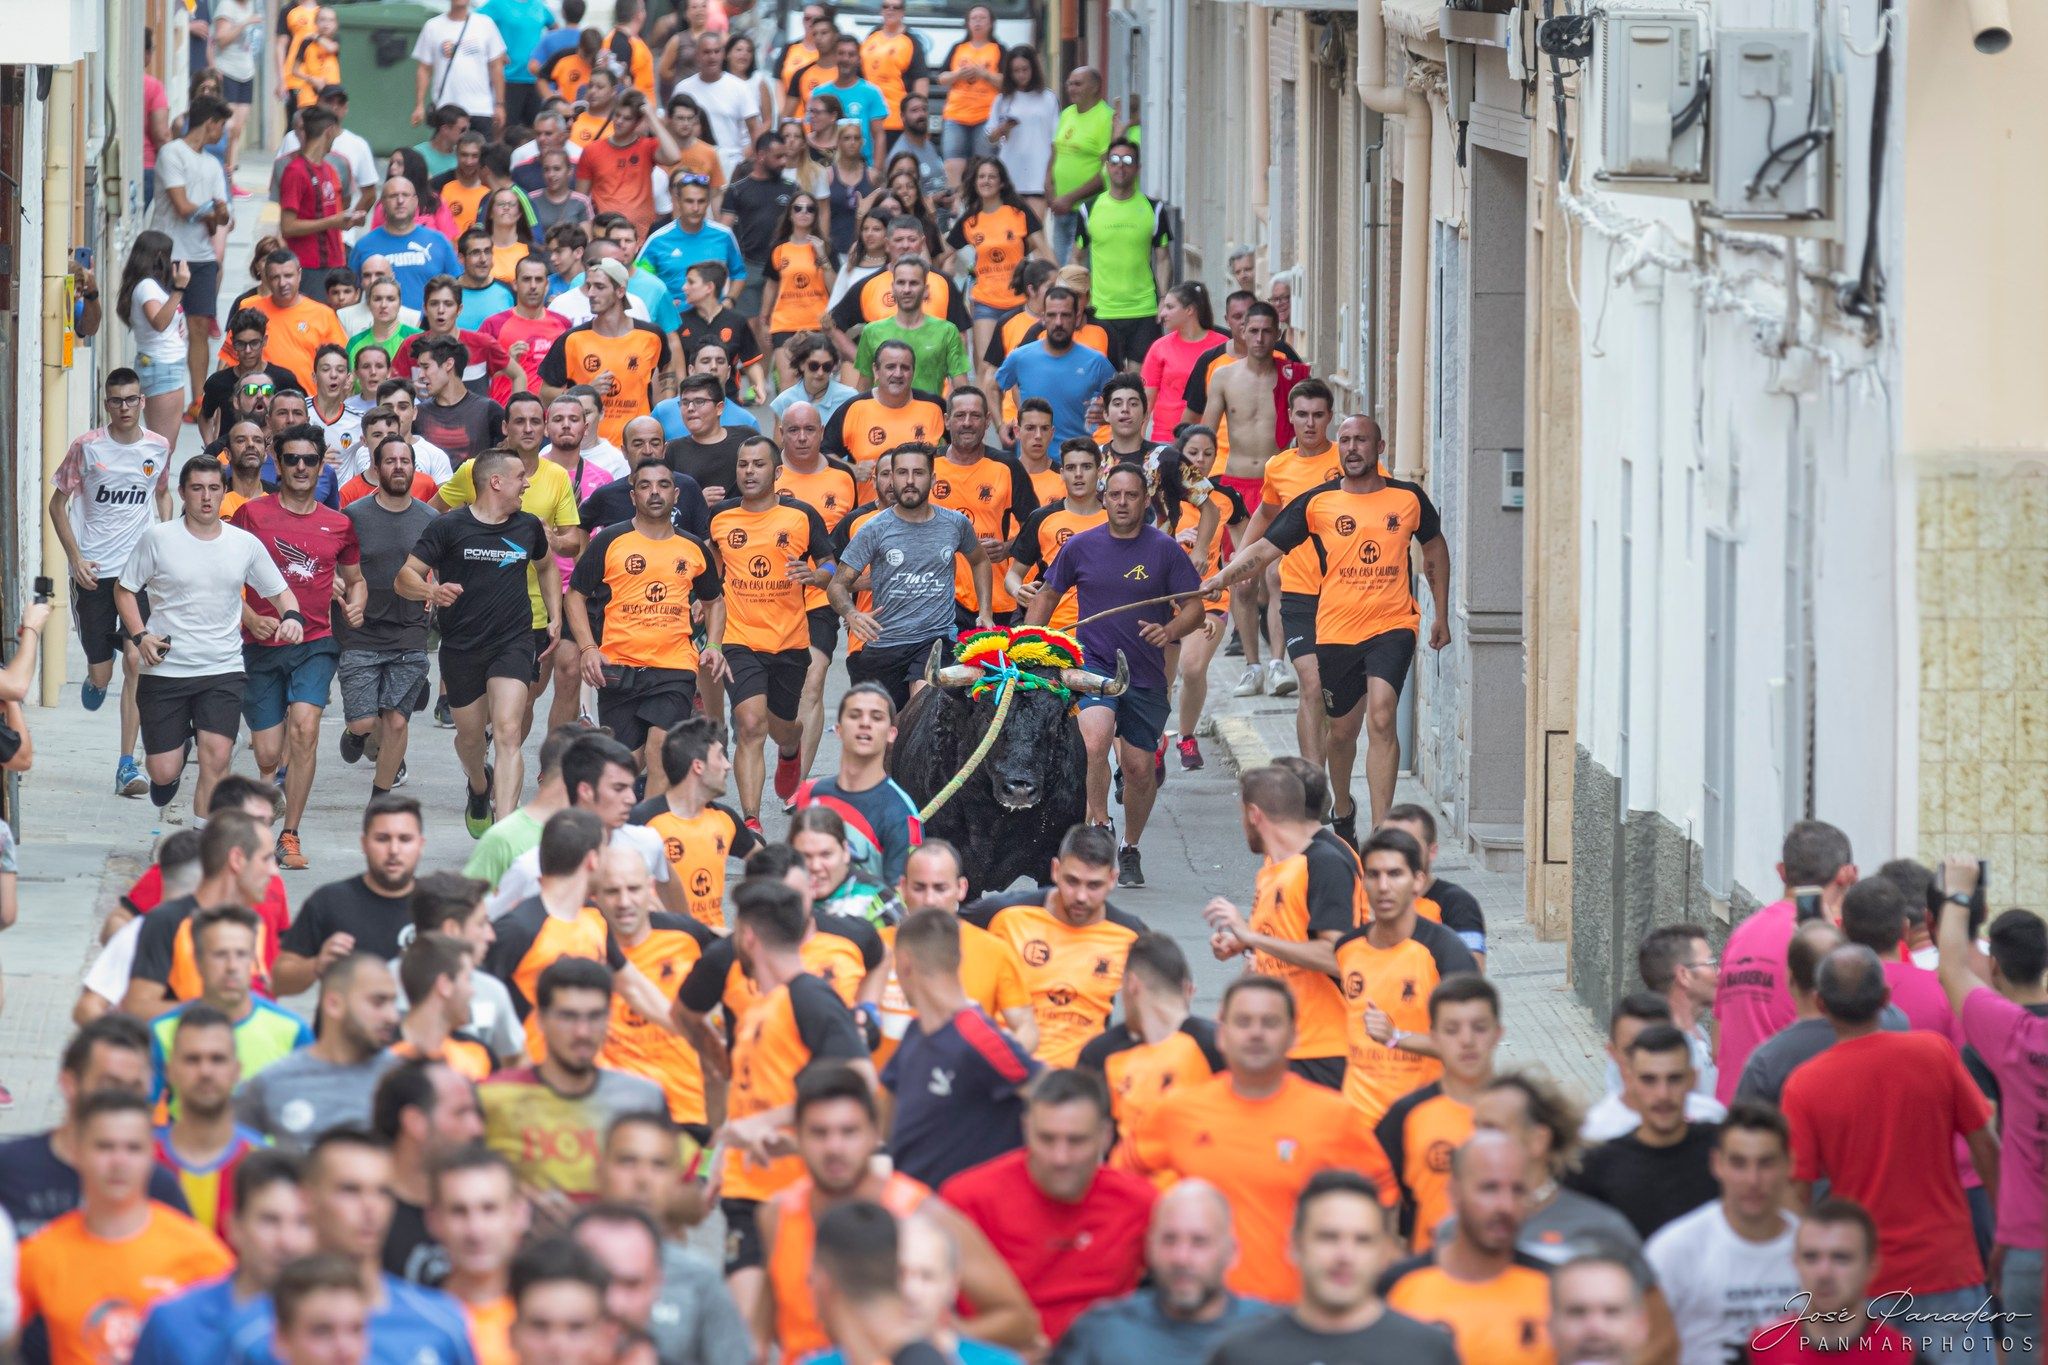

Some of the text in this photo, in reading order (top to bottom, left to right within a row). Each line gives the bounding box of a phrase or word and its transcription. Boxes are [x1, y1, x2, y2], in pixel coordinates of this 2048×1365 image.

[95, 484, 147, 504] bwin
[464, 549, 527, 560] POWERADE
[750, 580, 764, 591] CASA
